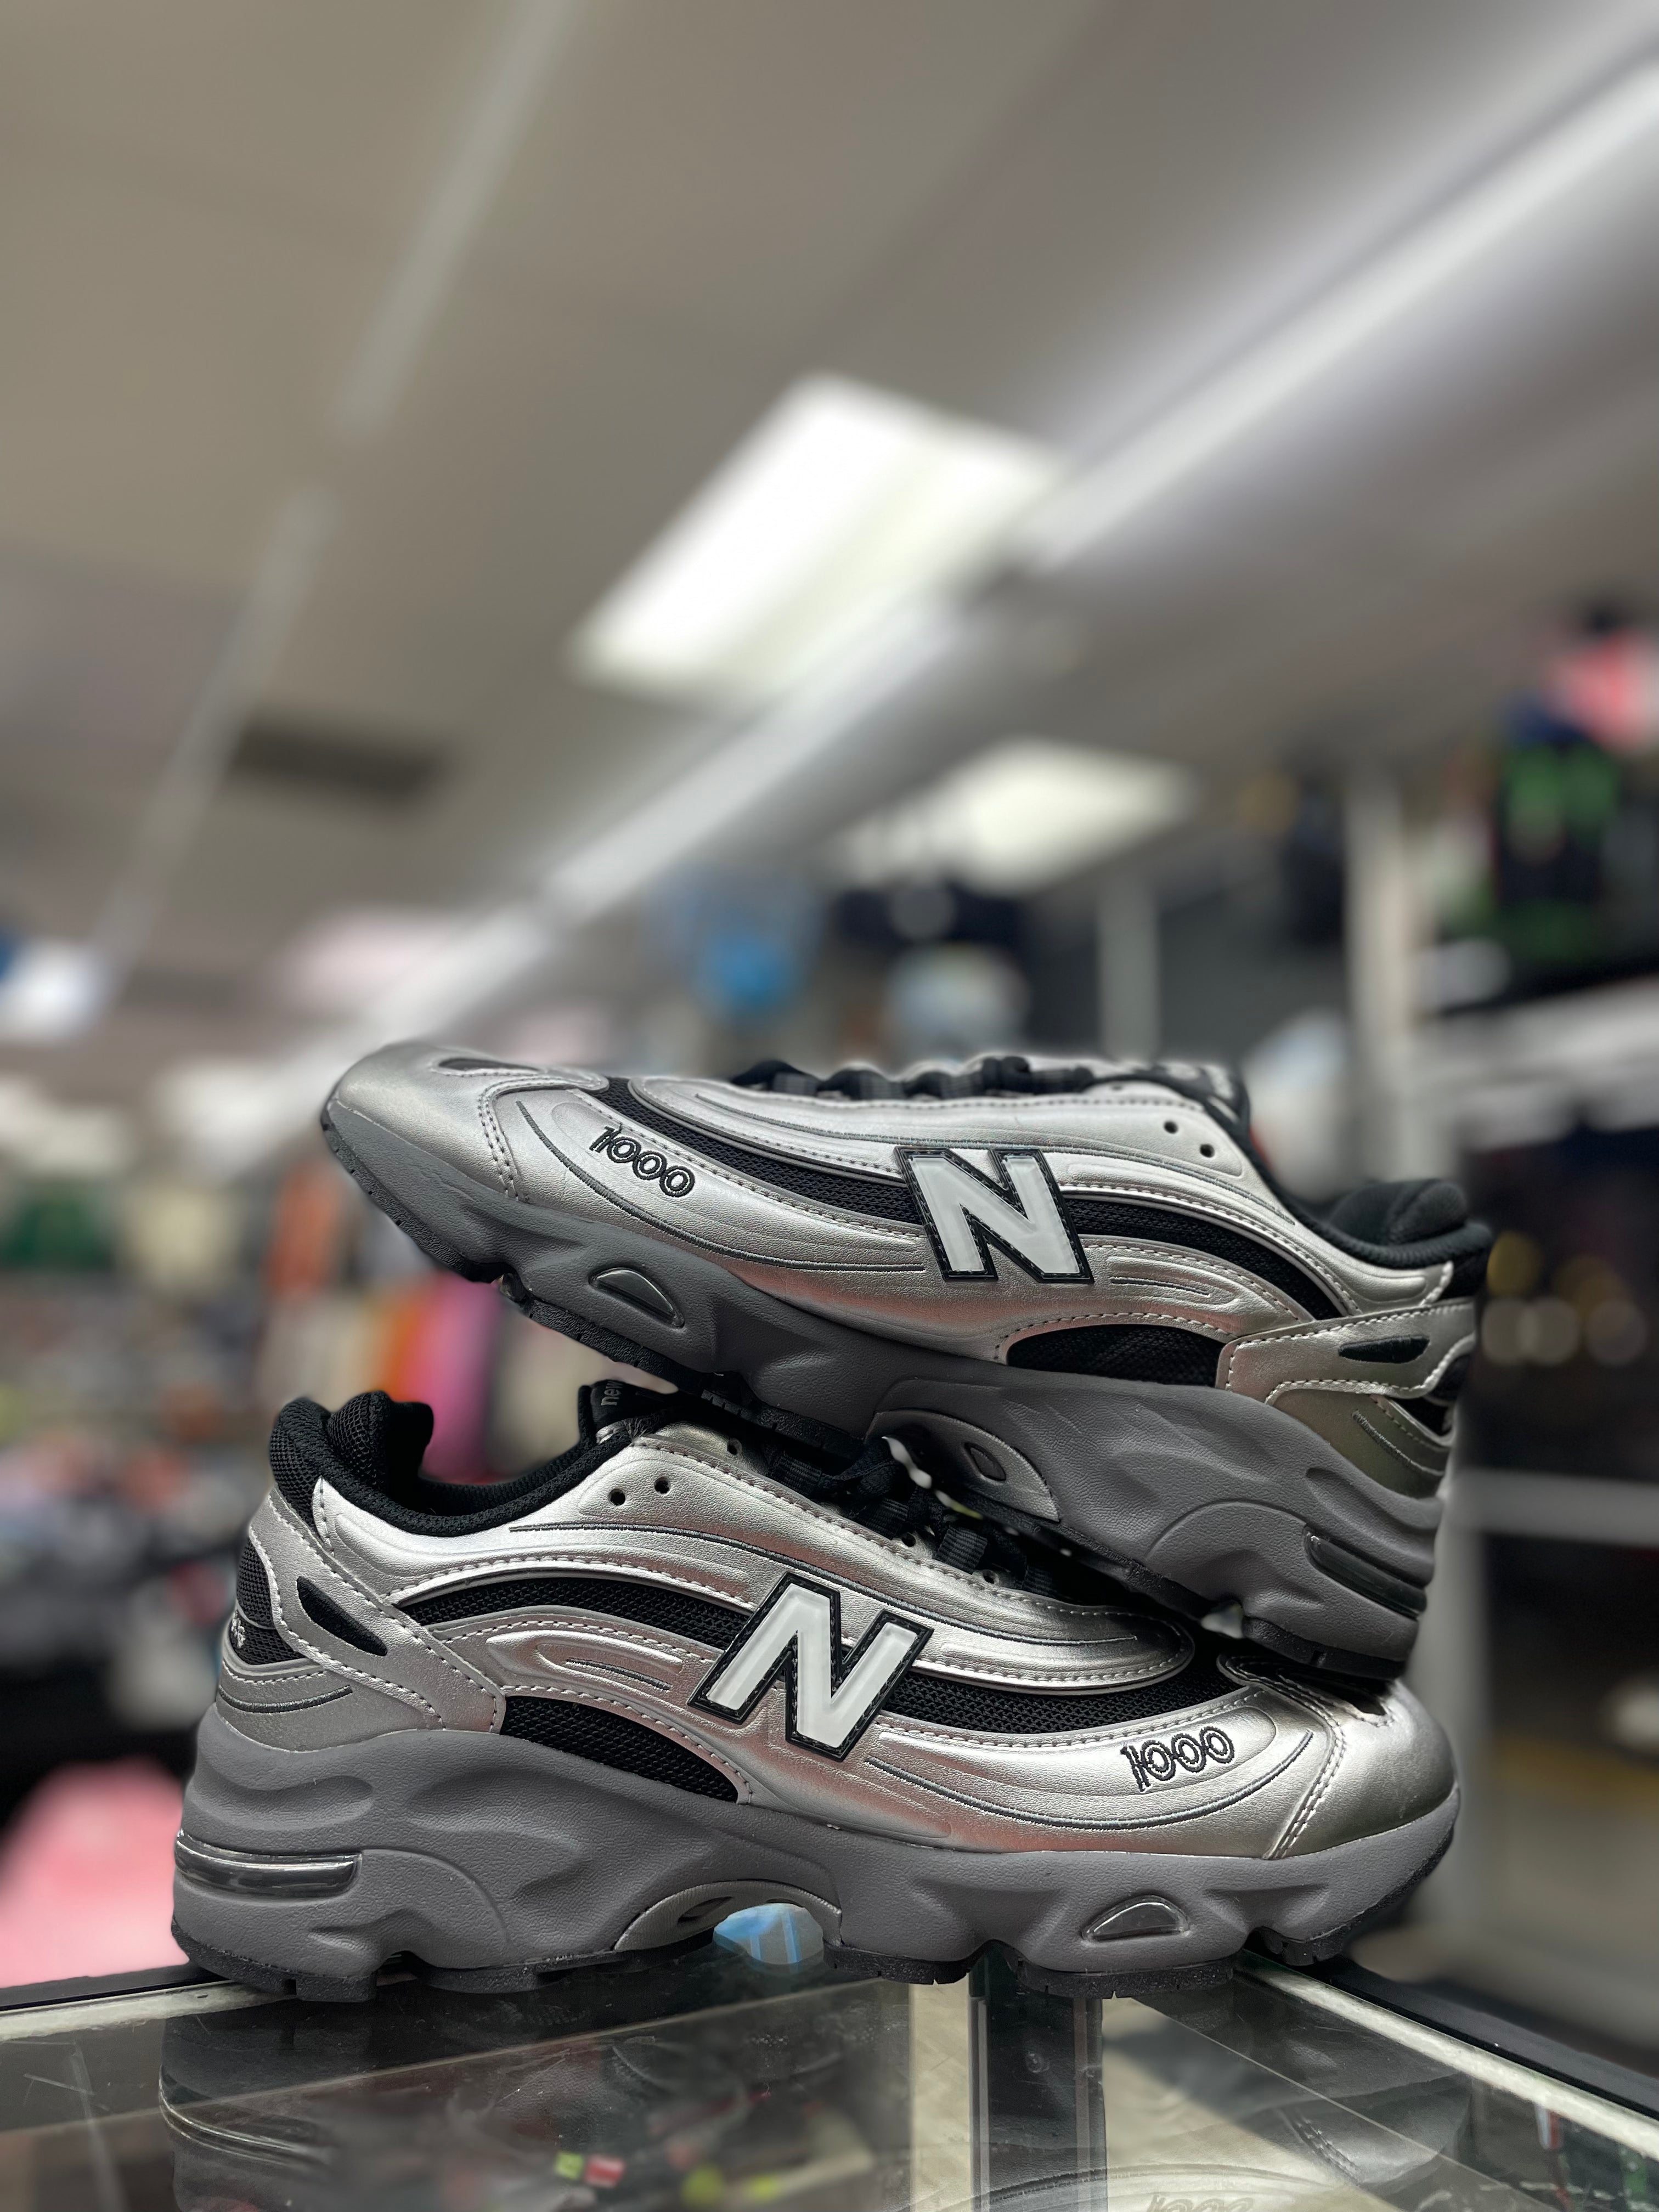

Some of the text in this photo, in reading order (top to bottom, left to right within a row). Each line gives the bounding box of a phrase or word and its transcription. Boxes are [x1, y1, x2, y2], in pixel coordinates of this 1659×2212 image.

[589, 1125, 695, 1198] 1000
[894, 1146, 1095, 1284] N
[687, 1571, 934, 1762] N
[1120, 1726, 1235, 1792] 1000
